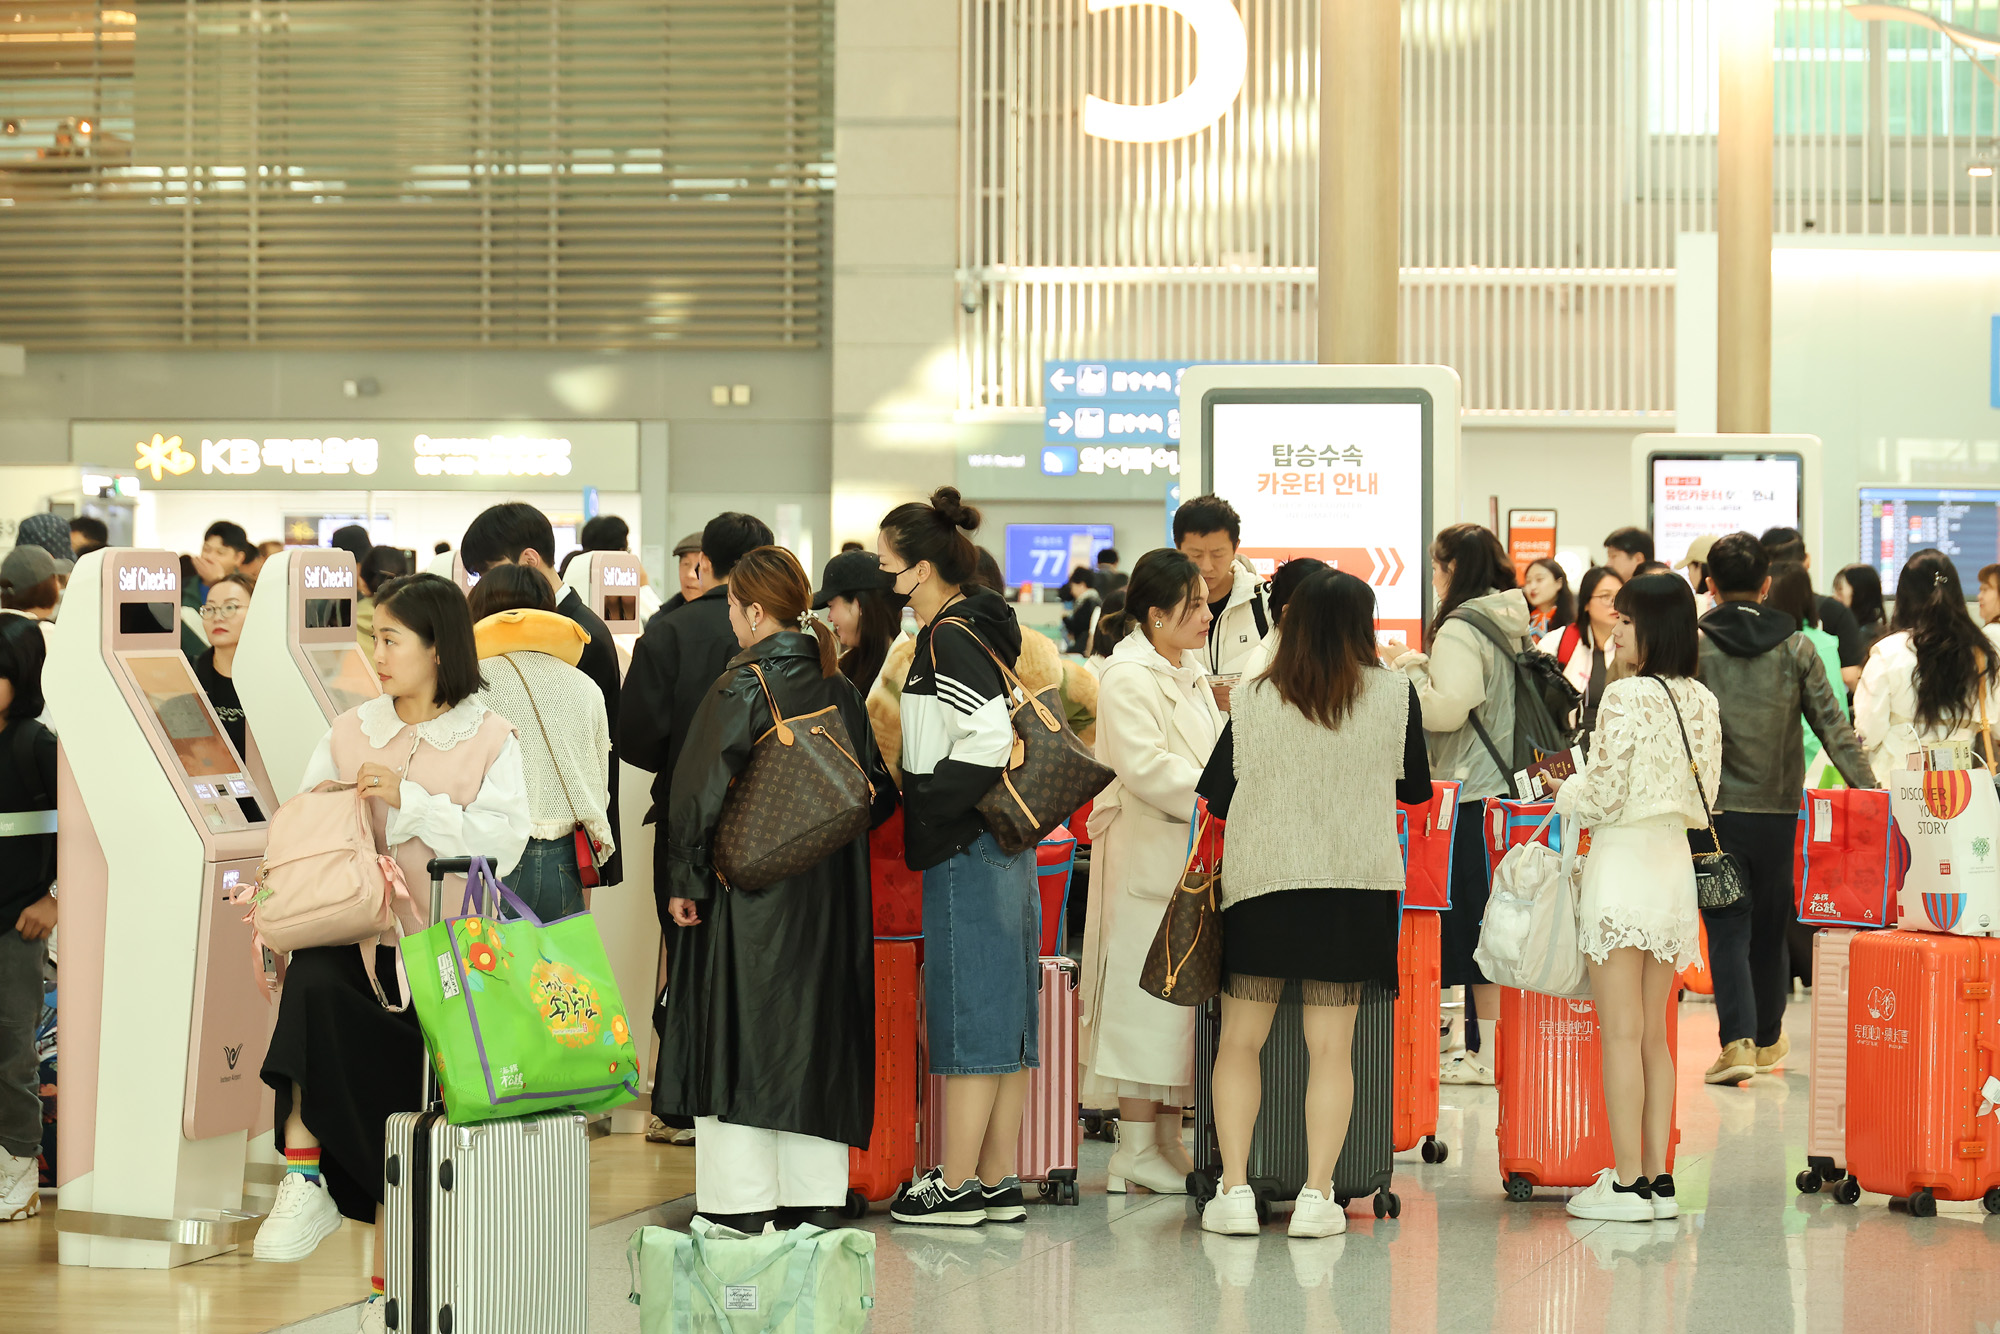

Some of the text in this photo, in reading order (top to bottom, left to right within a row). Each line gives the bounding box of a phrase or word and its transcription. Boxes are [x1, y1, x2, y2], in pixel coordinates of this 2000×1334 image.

[202, 438, 261, 474] KB
[1272, 444, 1363, 467] 탑승수속
[1257, 472, 1378, 495] 카운터 안내
[1029, 549, 1067, 577] 77
[119, 566, 176, 591] Self Check-in
[304, 565, 353, 588] Self Check-in
[603, 566, 637, 586] Self Check-in
[1901, 787, 1947, 801] DISCOVER
[1919, 804, 1948, 818] YOUR
[1918, 821, 1949, 834] STORY
